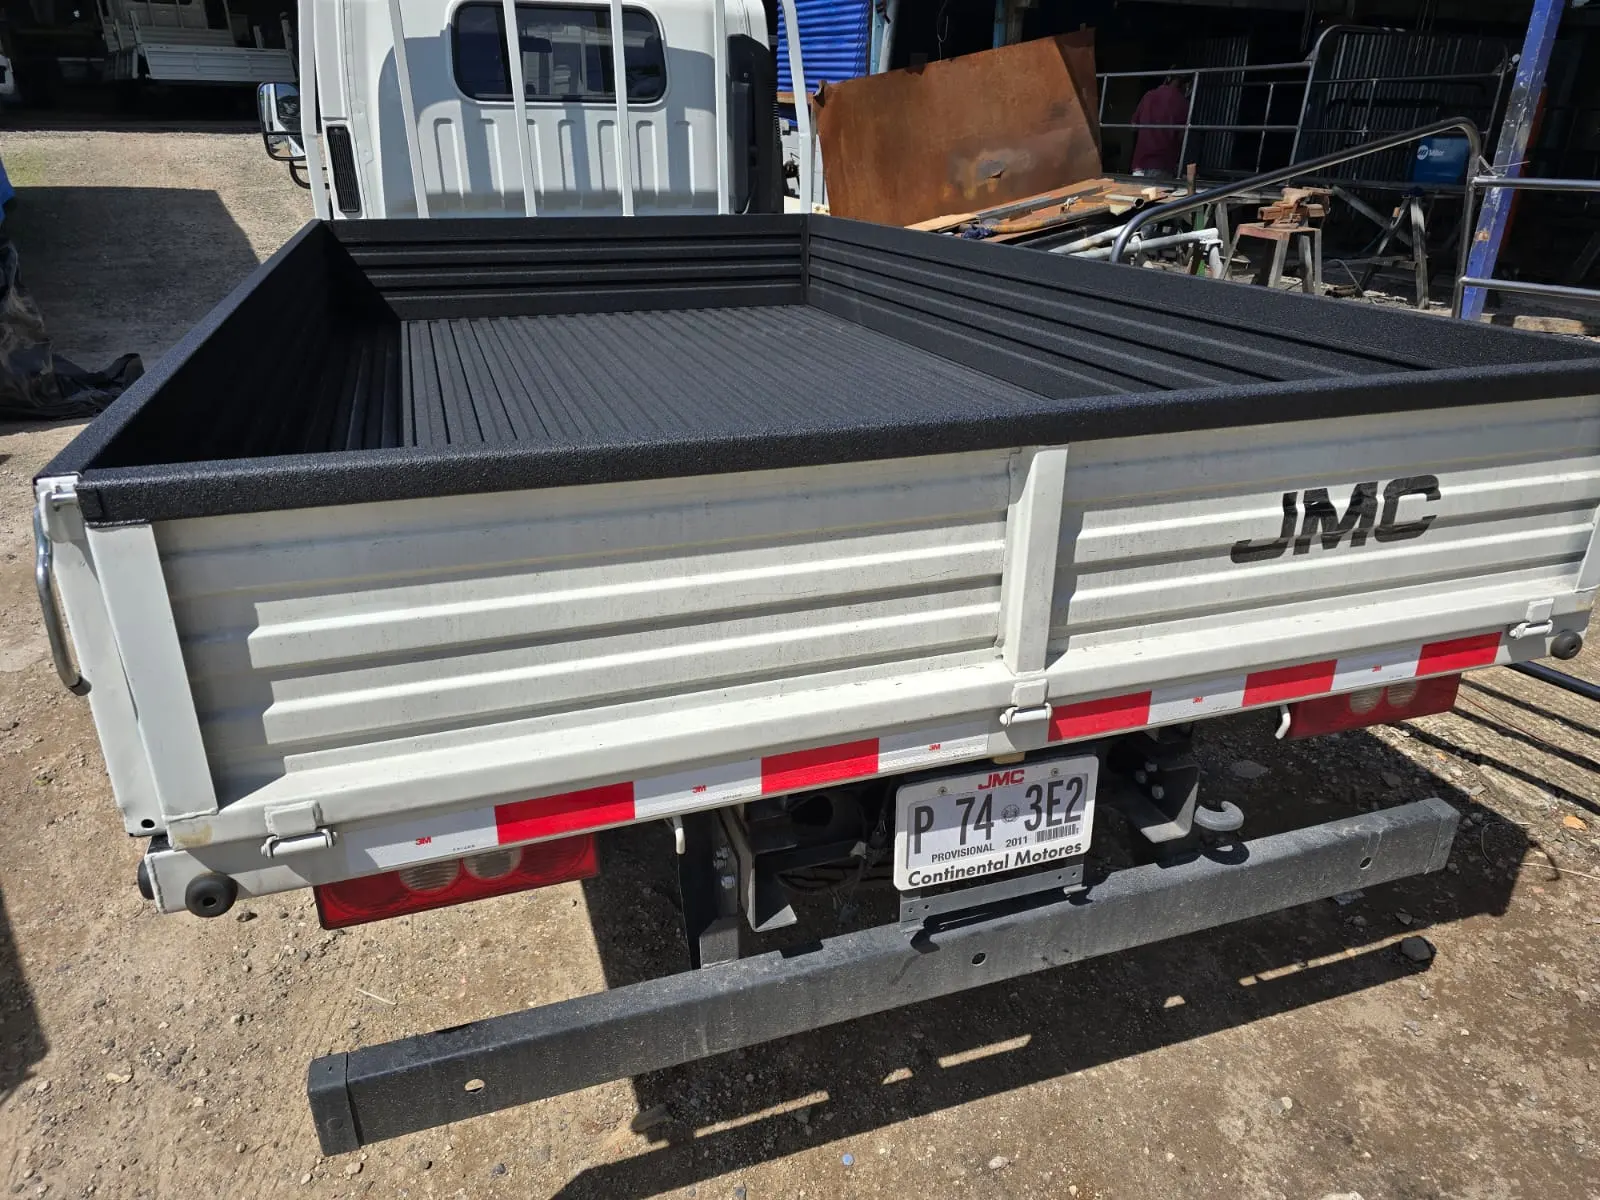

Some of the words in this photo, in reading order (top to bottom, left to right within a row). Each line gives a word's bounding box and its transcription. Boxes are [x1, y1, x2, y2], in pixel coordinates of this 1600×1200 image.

[1230, 474, 1441, 564] JMC
[692, 785, 707, 793] 3M
[978, 769, 1025, 790] JMC
[914, 806, 935, 854] P
[955, 793, 995, 845] 74
[1024, 776, 1083, 832] 3E2
[415, 836, 432, 846] 3M
[931, 843, 995, 863] PROVISIONAL
[1005, 836, 1029, 848] 2011
[908, 855, 1009, 887] Continental
[1014, 842, 1082, 867] Motores
